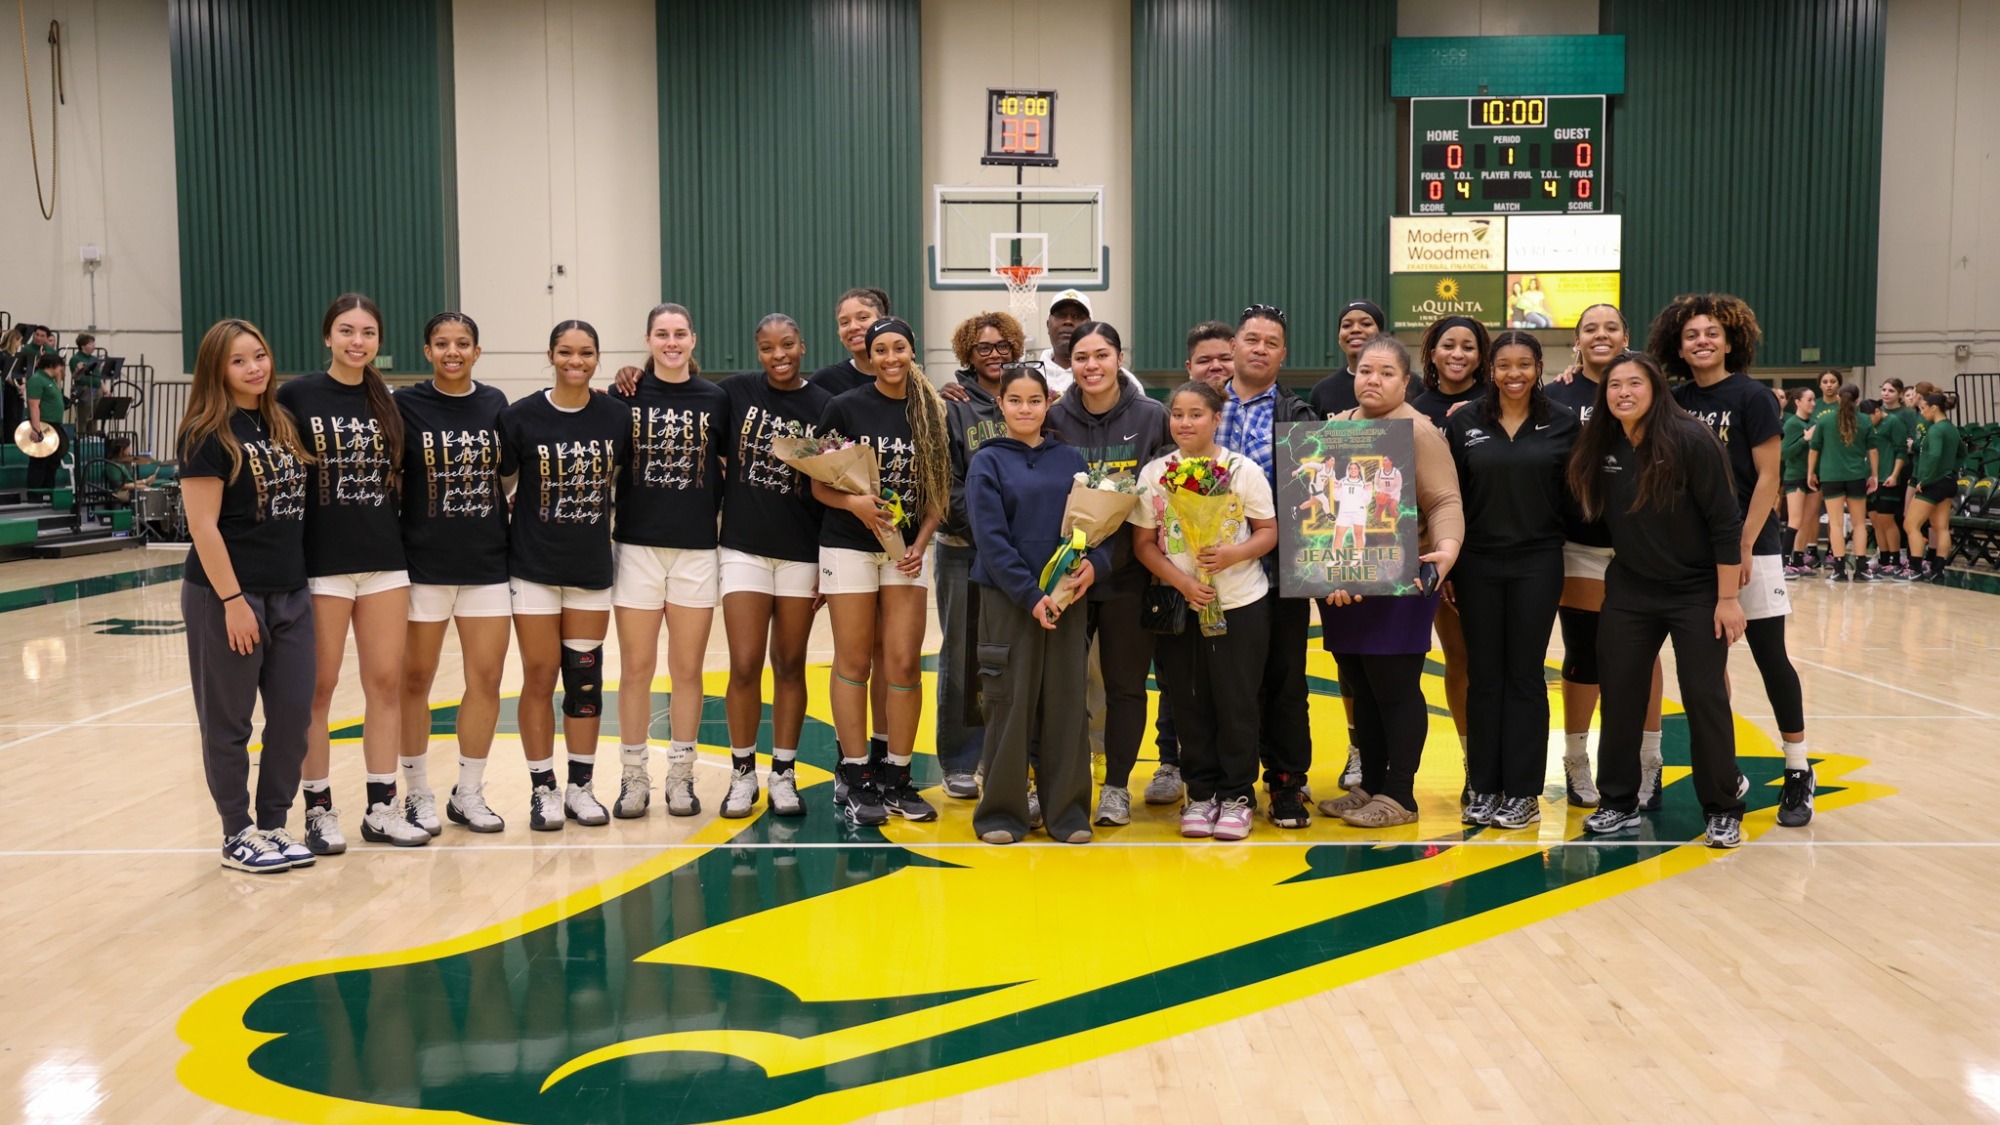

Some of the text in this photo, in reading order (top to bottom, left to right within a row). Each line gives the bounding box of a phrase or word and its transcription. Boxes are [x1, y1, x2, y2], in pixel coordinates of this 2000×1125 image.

[1002, 97, 1048, 116] 10:00
[1483, 100, 1543, 125] 10:00
[1426, 130, 1459, 142] HOME
[1493, 135, 1521, 144] PERIOD
[1554, 128, 1591, 140] GUEST
[1447, 145, 1463, 169] 0
[1508, 147, 1514, 165] 1
[1576, 143, 1592, 168] 0
[1421, 172, 1445, 181] FOULS
[1453, 171, 1474, 180] T.O.L.
[1481, 171, 1533, 180] PLAYER FOUL
[1540, 170, 1561, 179] T.O.L.
[1569, 170, 1594, 179] FOULS
[1429, 181, 1443, 200] 0
[1457, 181, 1470, 199] 4
[1544, 181, 1557, 198] 4
[1577, 179, 1591, 198] 0
[1420, 203, 1445, 212] SCORE
[1493, 203, 1520, 211] MATCH
[1568, 202, 1593, 211] SCORE
[1408, 229, 1469, 243] Modern
[1408, 246, 1490, 260] Woodmen
[310, 416, 381, 434] BLAC
[631, 407, 710, 427] BLACK
[422, 430, 502, 448] BLACK
[632, 422, 709, 441] BLACK
[314, 432, 384, 452] BLAC
[537, 440, 614, 460] BLACK
[424, 446, 502, 466] BLACK
[540, 456, 614, 476] BLACK
[644, 456, 694, 475] pride
[749, 460, 792, 475] pride
[644, 471, 693, 490] history
[748, 470, 791, 494] history
[336, 488, 385, 507] history
[442, 481, 491, 505] pride
[555, 490, 604, 511] pride
[442, 500, 493, 518] history
[554, 507, 603, 525] history
[1297, 547, 1401, 563] JEANETTE
[1326, 565, 1377, 582] FINE
